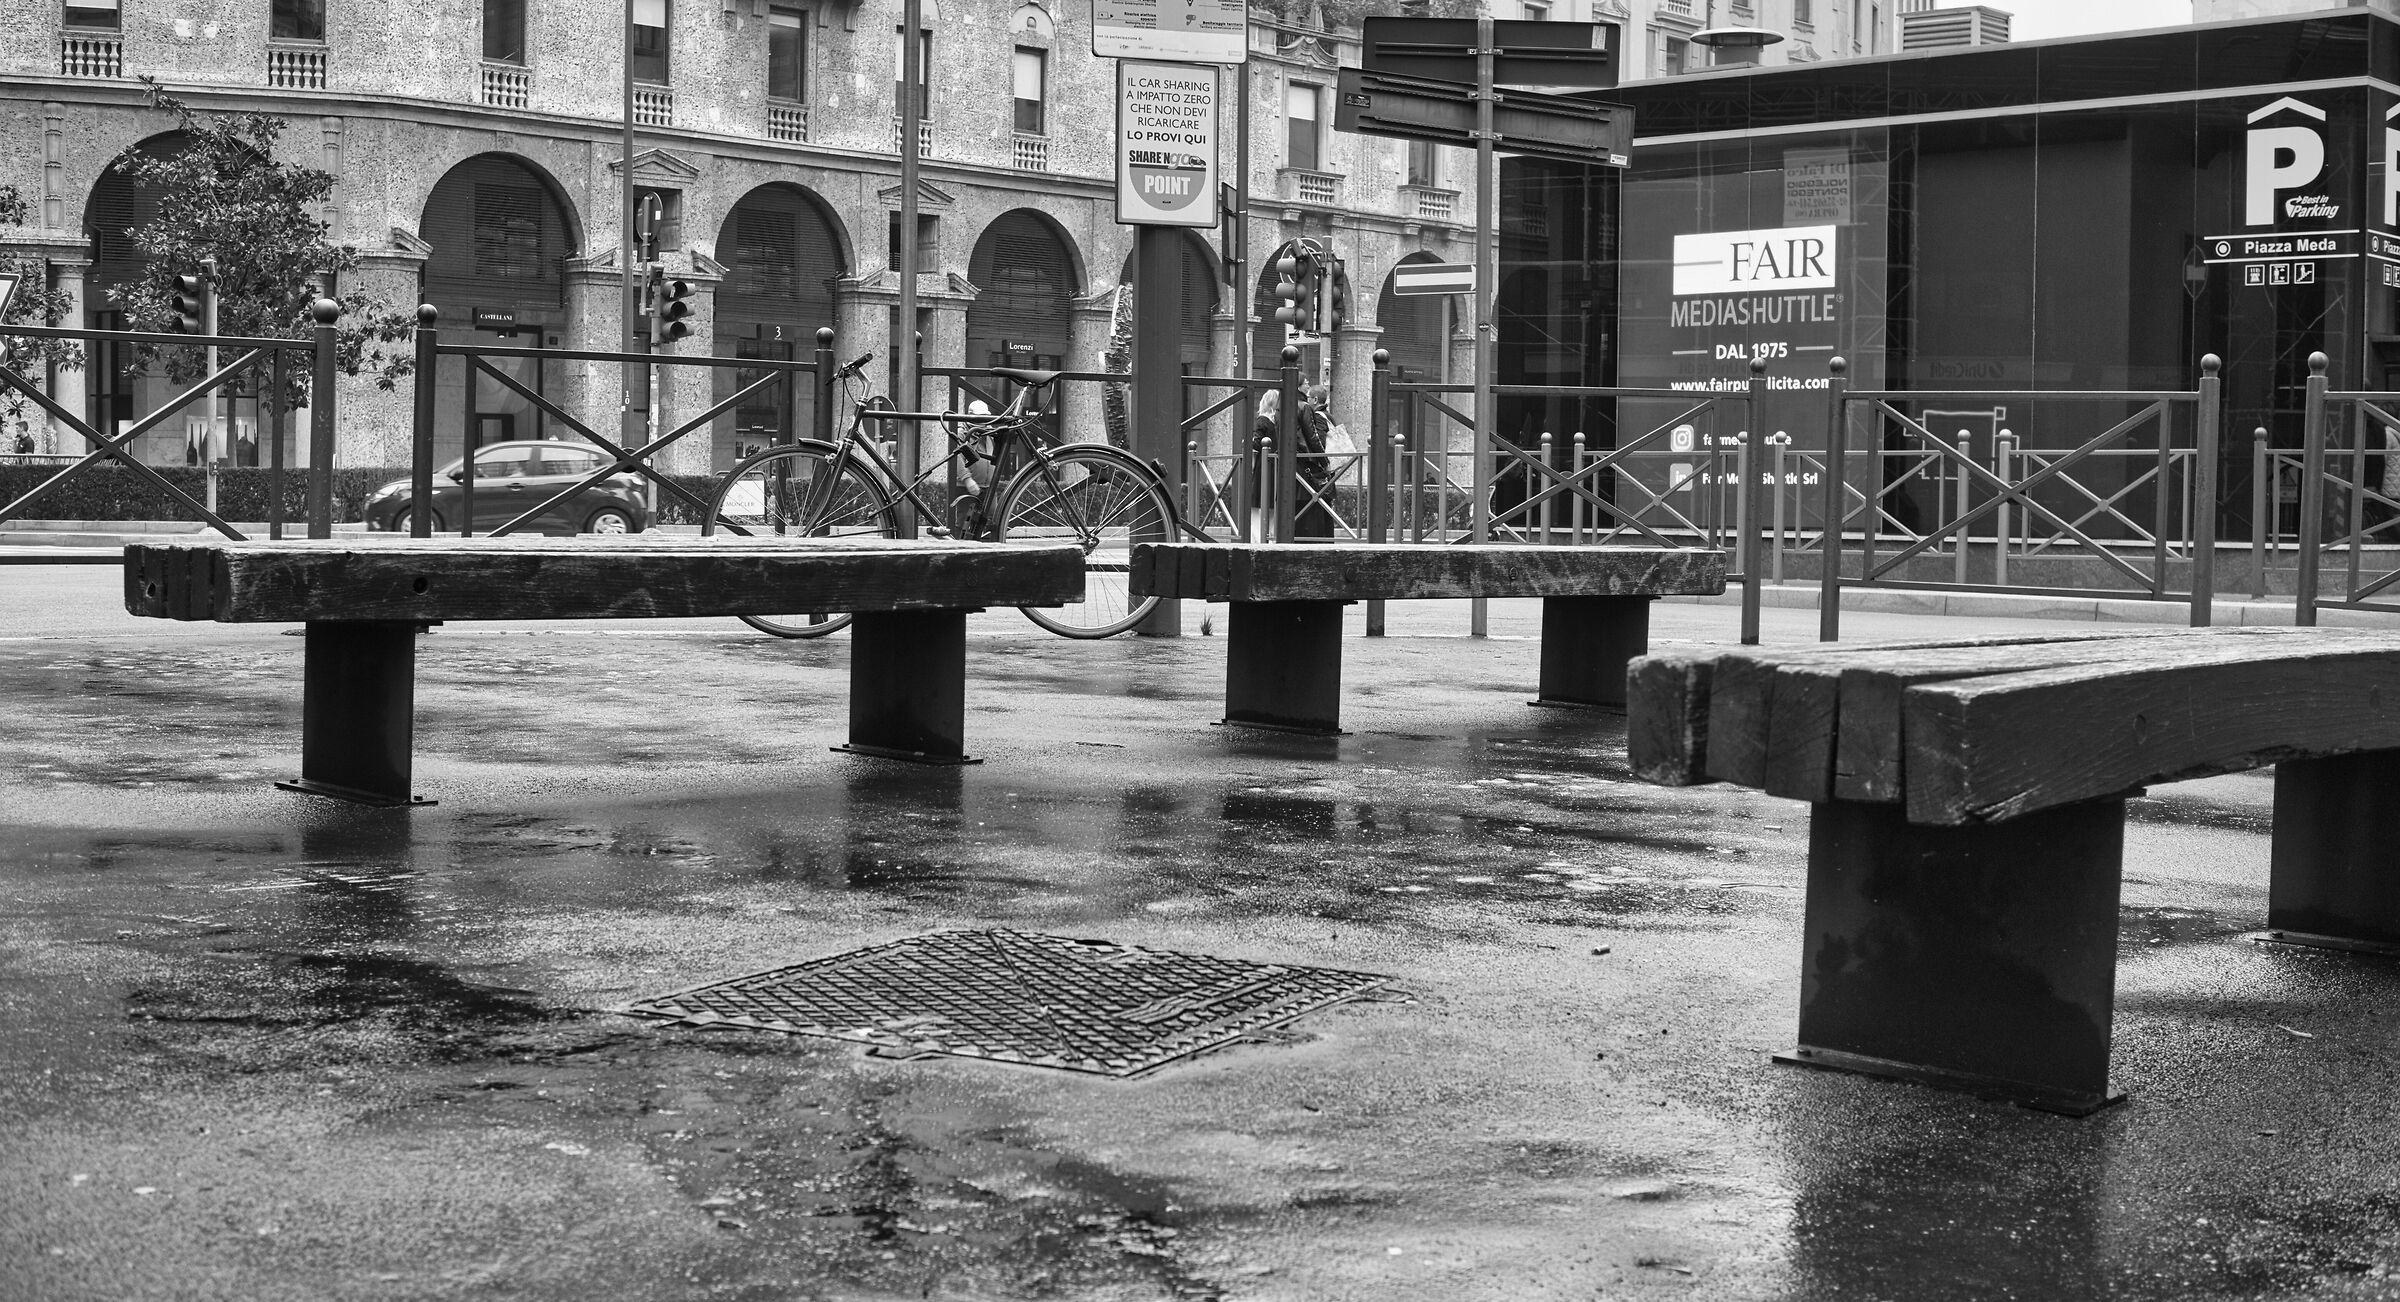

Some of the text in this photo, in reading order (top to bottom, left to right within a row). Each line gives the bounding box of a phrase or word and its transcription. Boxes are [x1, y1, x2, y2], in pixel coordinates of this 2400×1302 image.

[1127, 77, 1210, 92] IL CAR SHARING
[1126, 90, 1211, 105] A IMPATTO ZERO
[1130, 103, 1207, 118] CHE NON DEVI
[1137, 116, 1199, 130] RICARICARE
[1127, 130, 1206, 145] LO PROVI QUI
[2246, 126, 2325, 226] P
[1144, 174, 1191, 195] POINT
[2301, 195, 2330, 205] Best in
[2291, 204, 2340, 219] Parking
[2245, 238, 2337, 254] Piazza Meda
[2384, 242, 2400, 257] Piazz
[1729, 238, 1831, 282] FAIR
[775, 326, 781, 338] 3
[1009, 342, 1034, 351] Lorenzi
[1716, 342, 1788, 359] DAL 1975
[1803, 472, 1818, 485] Srl
